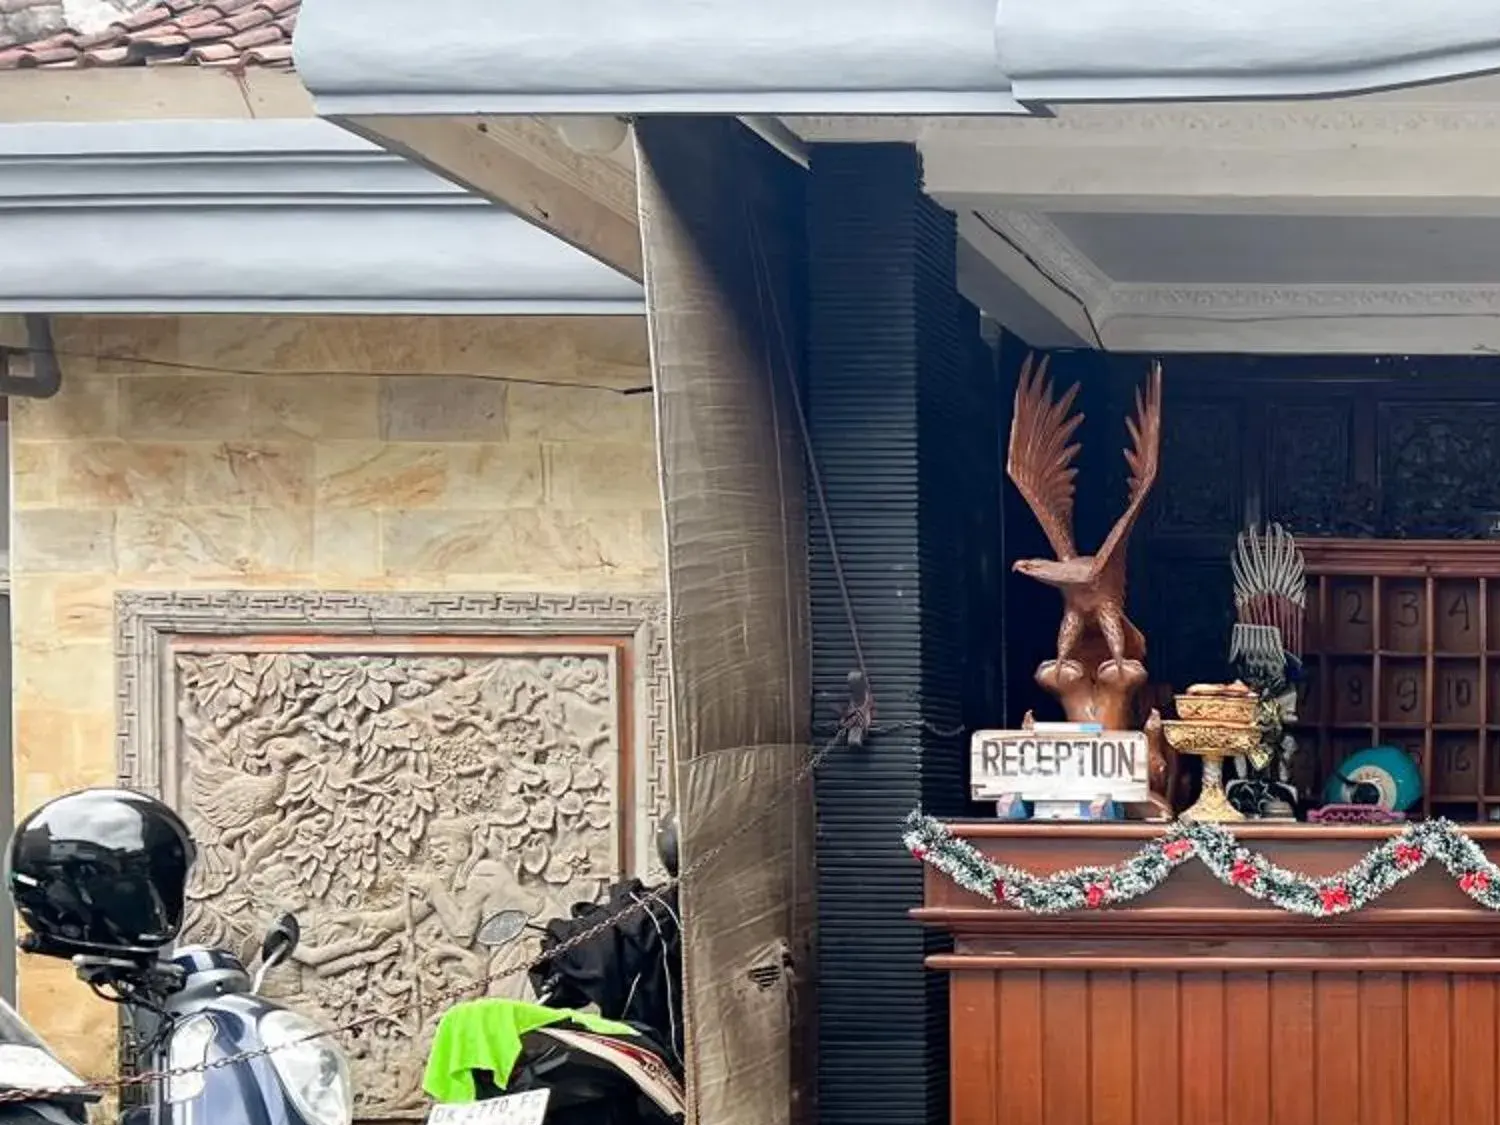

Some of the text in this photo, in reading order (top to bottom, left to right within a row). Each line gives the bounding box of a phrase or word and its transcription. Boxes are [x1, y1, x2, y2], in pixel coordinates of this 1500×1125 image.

[1344, 590, 1369, 625] 2
[1395, 590, 1420, 628] 3
[1447, 590, 1470, 634] 4
[1348, 677, 1363, 705] 8
[1397, 677, 1419, 712] 9
[1445, 678, 1472, 710] 10
[982, 740, 1135, 778] RECEPTION
[1445, 745, 1472, 773] 16
